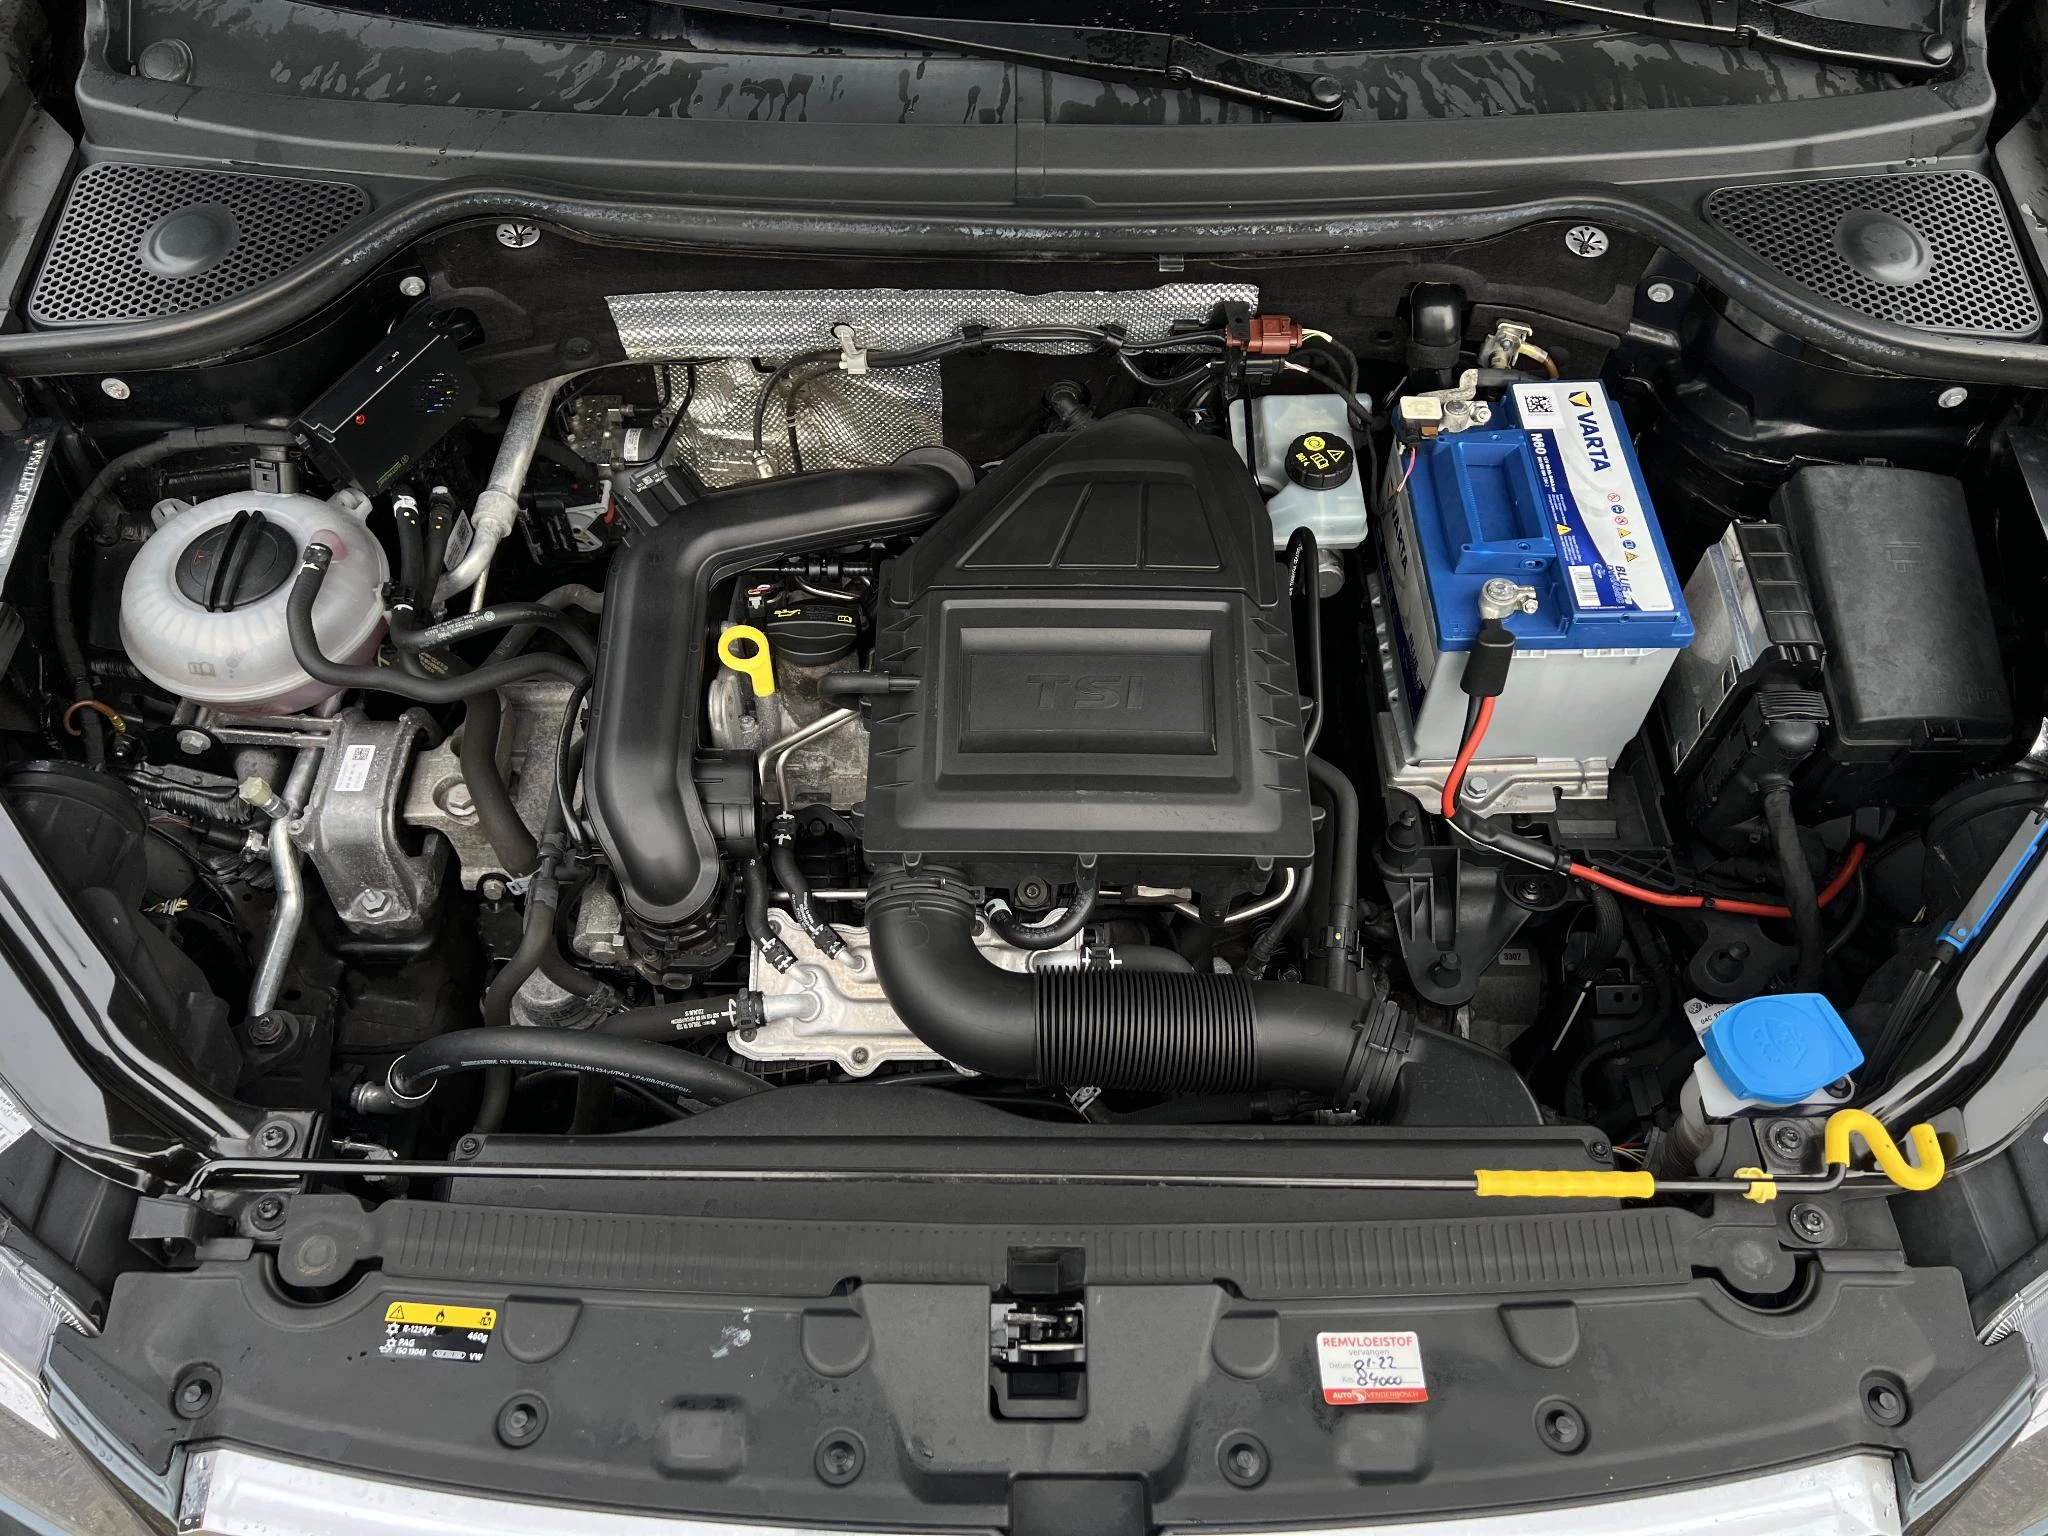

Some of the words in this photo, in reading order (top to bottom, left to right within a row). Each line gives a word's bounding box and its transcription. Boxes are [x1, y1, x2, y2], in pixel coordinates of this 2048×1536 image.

[1530, 433, 1546, 455] N60
[1577, 411, 1612, 472] VARTA
[1616, 566, 1632, 592] BLUE
[1026, 674, 1144, 710] TSI
[402, 1325, 436, 1336] R-1234yf
[398, 1338, 416, 1346] PAG
[467, 1332, 488, 1344] 460g
[1322, 1336, 1413, 1348] REMVLOEISTOF
[469, 1352, 483, 1361] VW
[1348, 1349, 1390, 1357] vervangen
[1356, 1368, 1402, 1387] 84000
